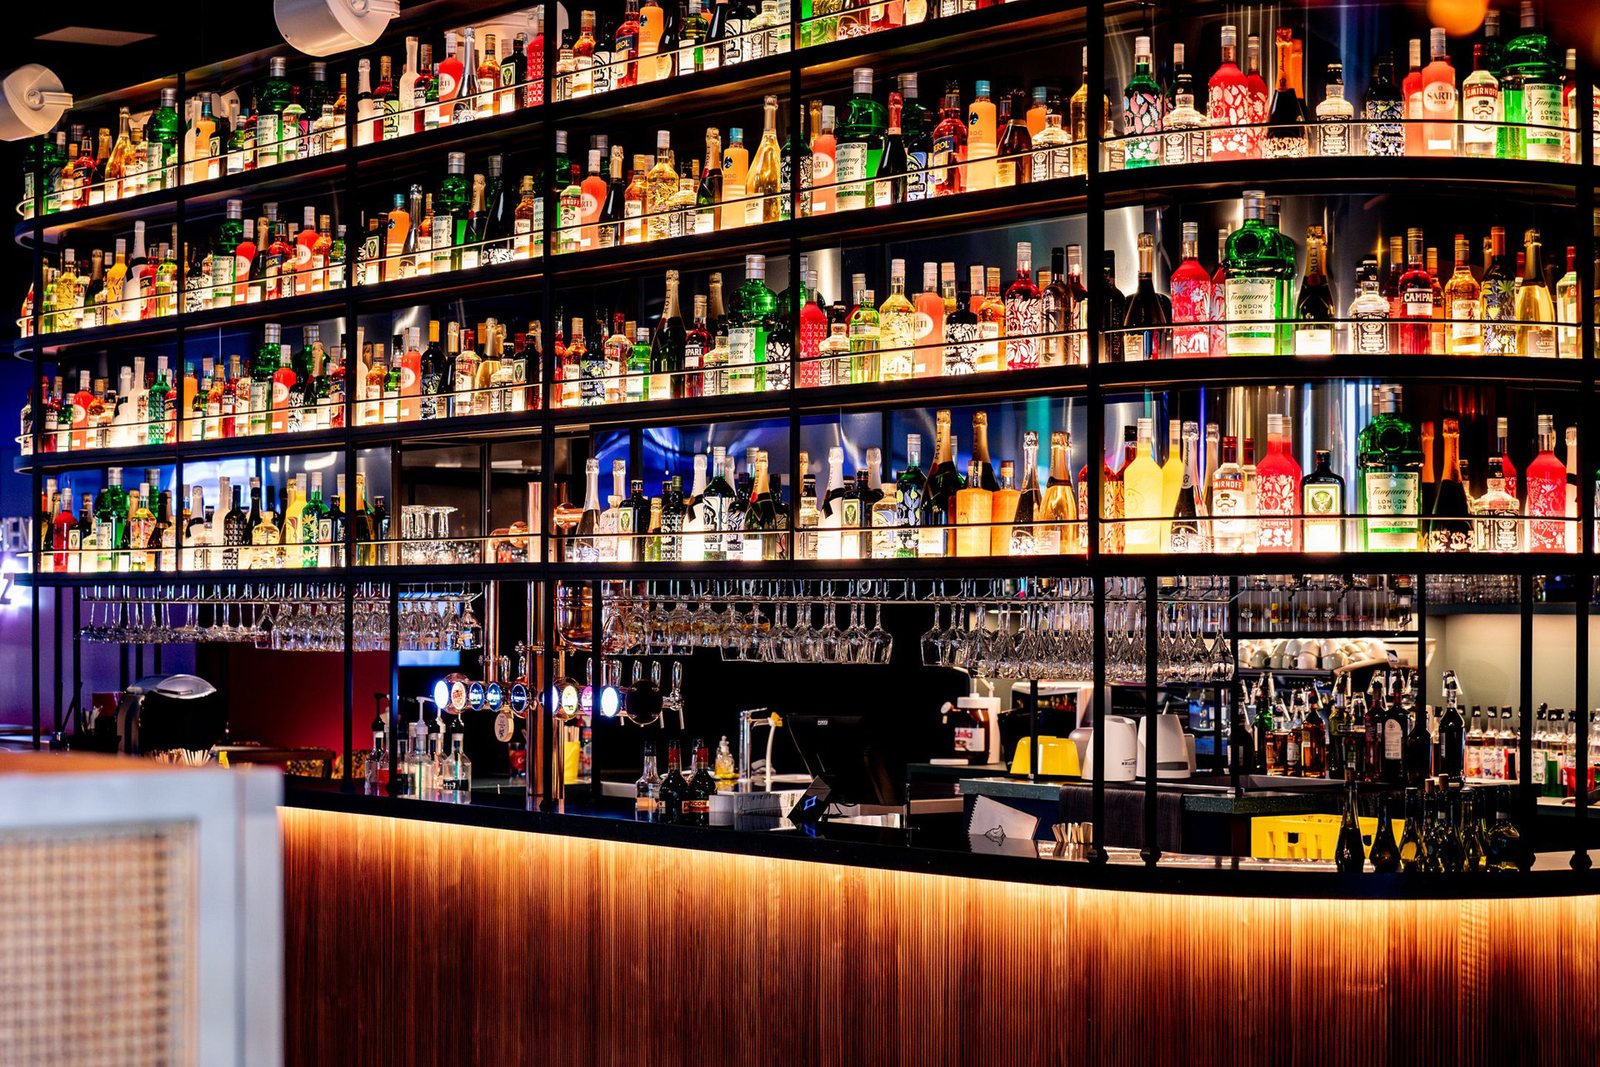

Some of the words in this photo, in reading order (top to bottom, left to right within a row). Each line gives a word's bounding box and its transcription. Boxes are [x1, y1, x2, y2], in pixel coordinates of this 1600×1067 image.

[934, 141, 950, 152] EROL
[1404, 292, 1433, 303] CAMPA
[1213, 481, 1243, 490] MIRNOFF
